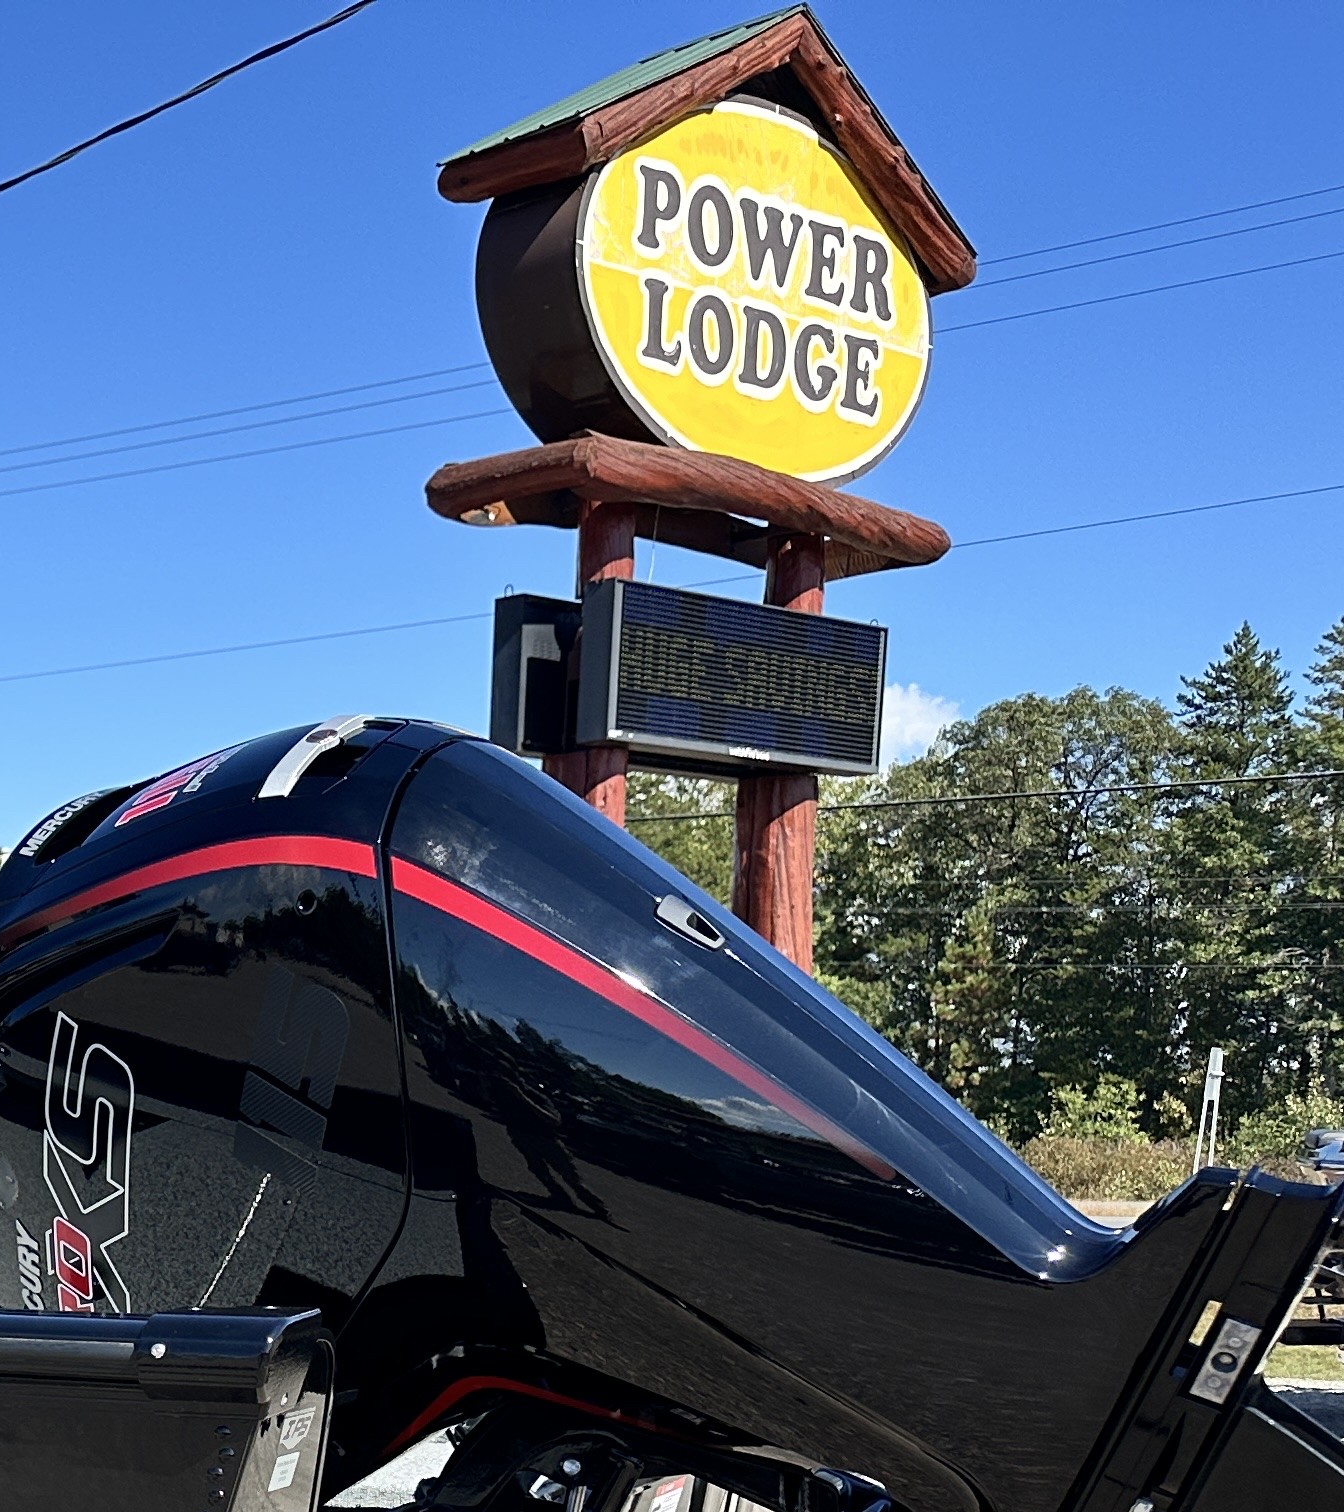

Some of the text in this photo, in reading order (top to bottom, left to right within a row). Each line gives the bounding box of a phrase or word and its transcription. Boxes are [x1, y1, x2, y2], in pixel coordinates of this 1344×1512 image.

[636, 165, 892, 321] POWER
[642, 277, 881, 418] LODGE
[19, 792, 102, 856] MERCURY
[16, 1219, 45, 1310] CURY
